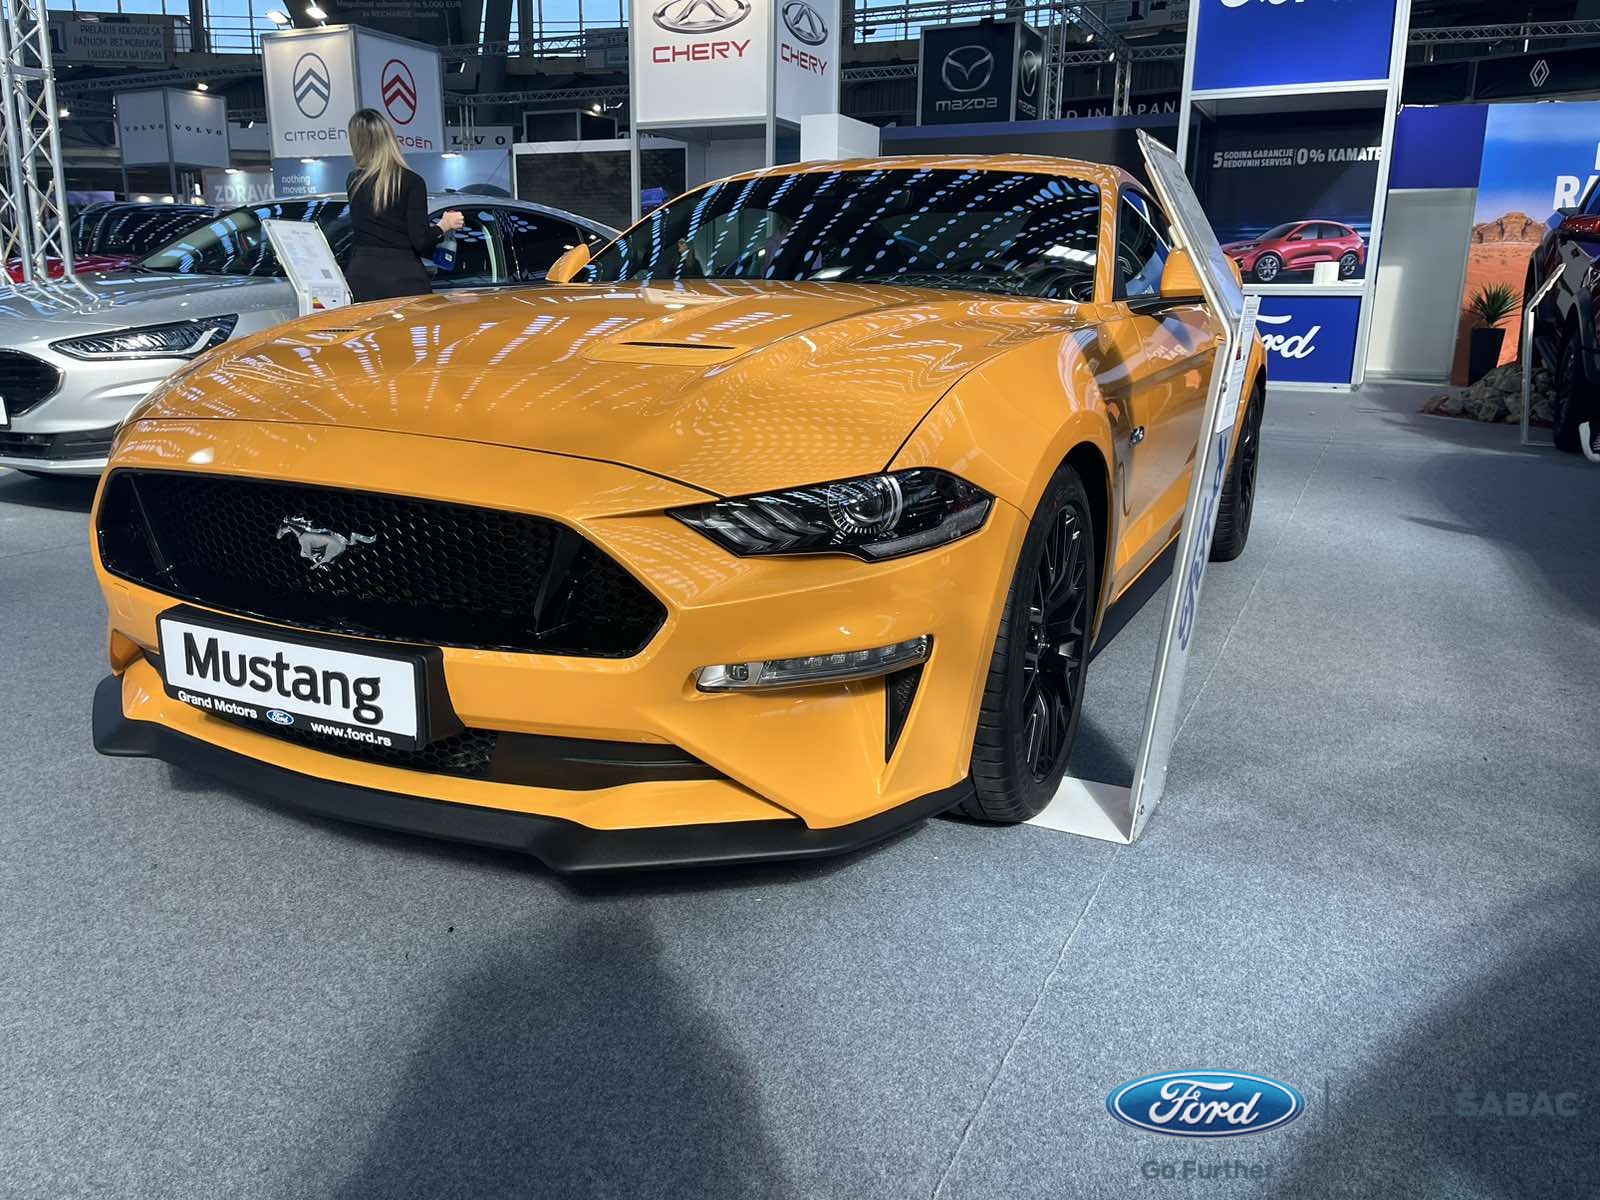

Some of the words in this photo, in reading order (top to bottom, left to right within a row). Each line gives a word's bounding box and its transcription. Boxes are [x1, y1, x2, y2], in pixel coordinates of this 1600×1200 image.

[653, 40, 750, 63] CHERY
[781, 43, 827, 75] CHERY
[125, 124, 164, 132] VOLVO
[175, 124, 222, 136] VOLVO
[1212, 152, 1223, 168] 5
[1223, 150, 1252, 159] GODINA
[1253, 148, 1294, 158] GARANCIJE
[1223, 158, 1260, 168] REDOVNIH
[1261, 157, 1292, 167] SERVISA
[281, 175, 311, 185] nothing
[282, 186, 307, 194] moves
[183, 632, 384, 725] Mustang
[178, 690, 213, 710] Grand
[214, 699, 258, 719] Motors
[270, 711, 291, 724] Ford
[310, 721, 392, 747] www.ford.rs
